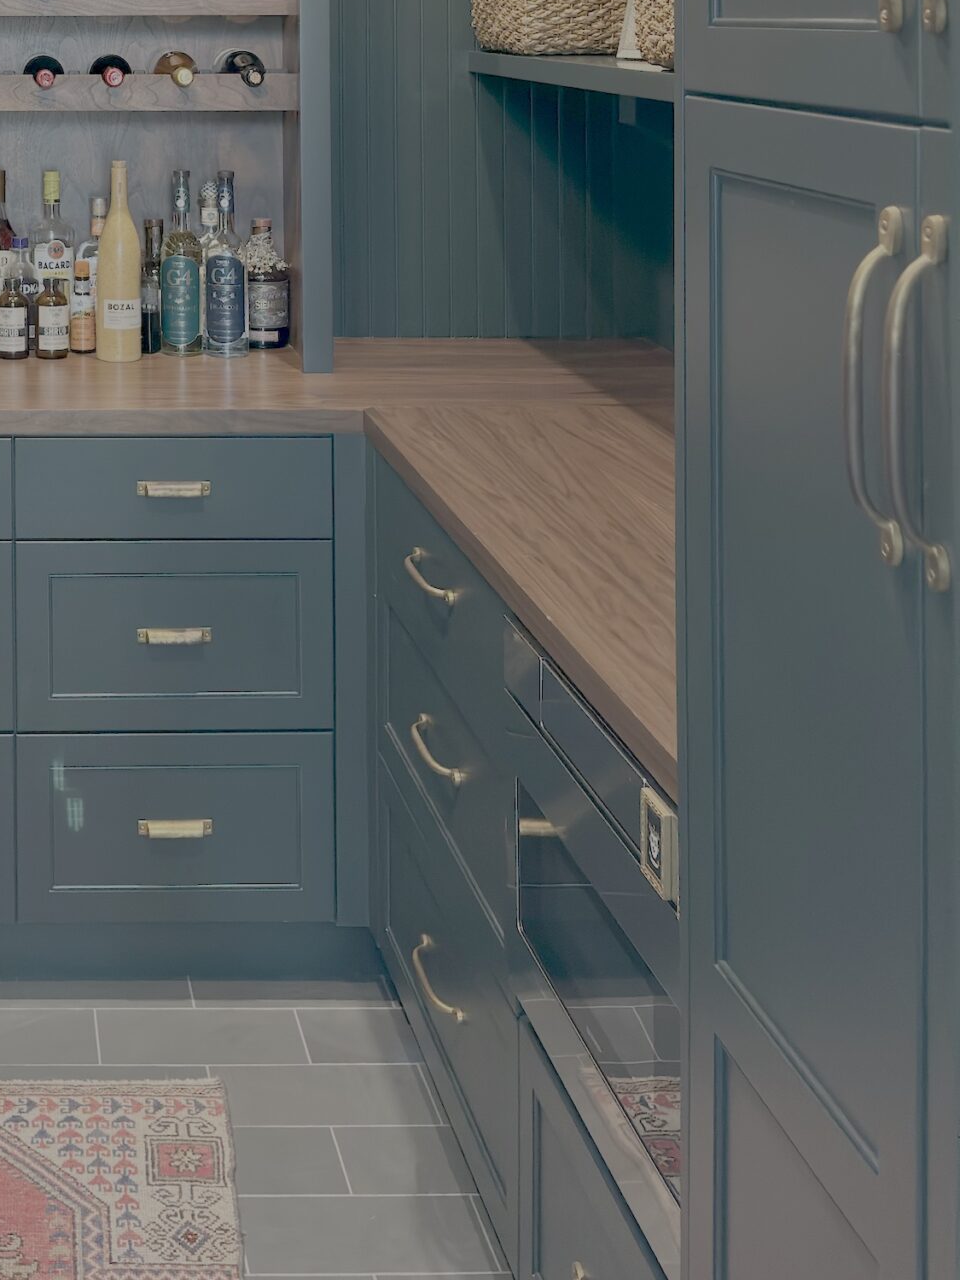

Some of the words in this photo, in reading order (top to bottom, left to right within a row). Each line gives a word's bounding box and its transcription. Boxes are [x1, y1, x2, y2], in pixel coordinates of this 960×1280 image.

[166, 269, 193, 286] G4
[211, 267, 238, 285] G4
[107, 303, 136, 311] BOZAL
